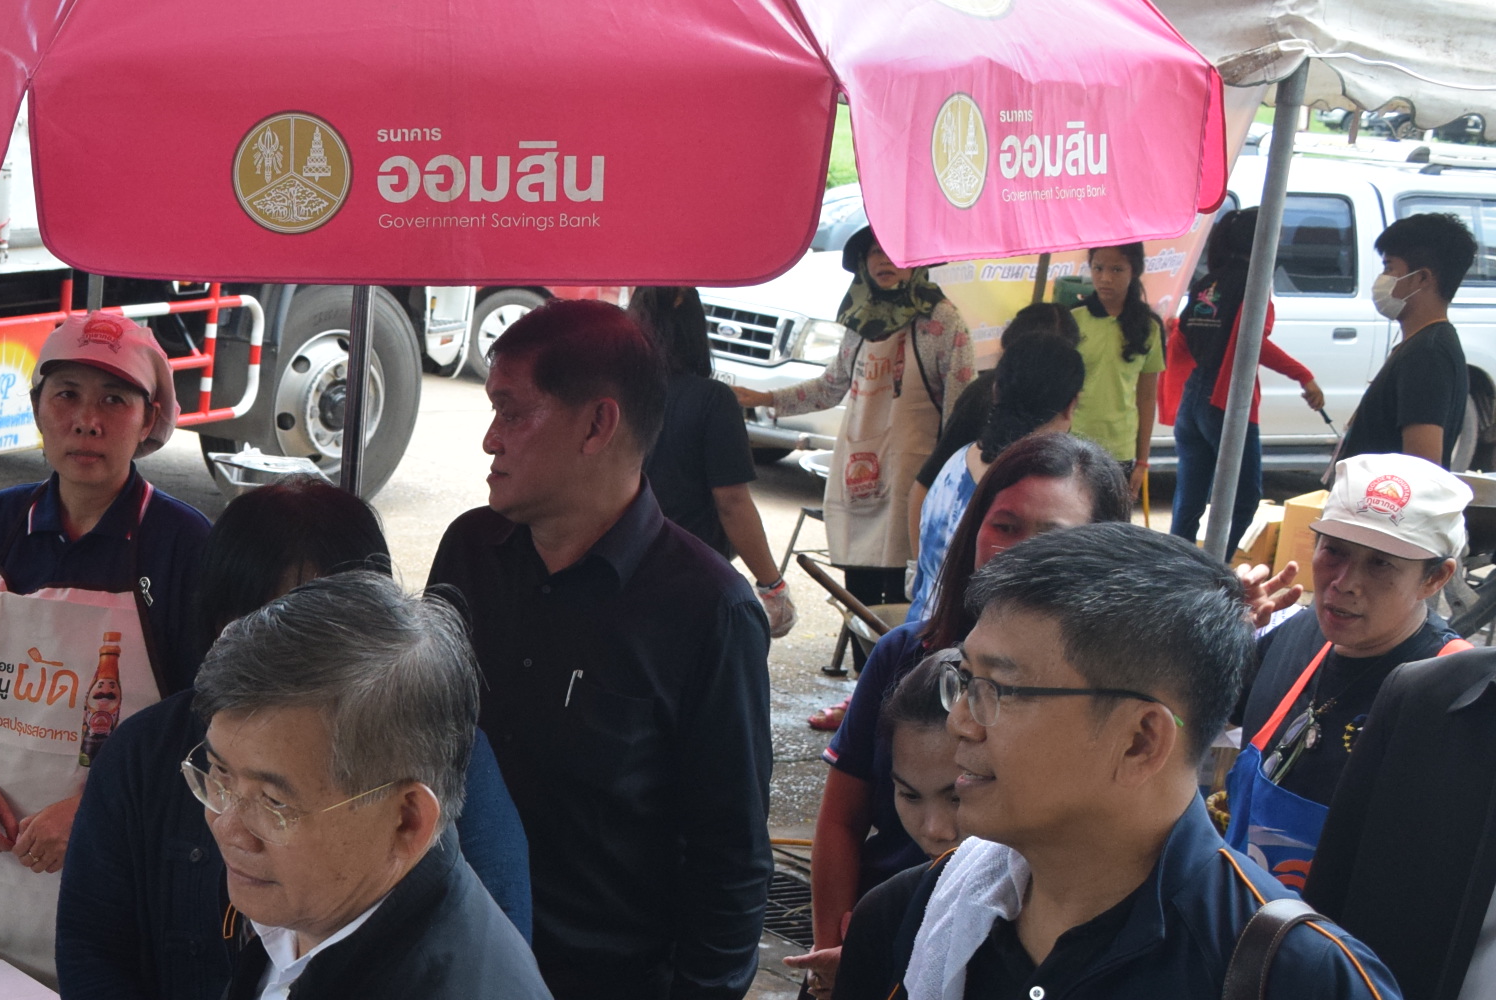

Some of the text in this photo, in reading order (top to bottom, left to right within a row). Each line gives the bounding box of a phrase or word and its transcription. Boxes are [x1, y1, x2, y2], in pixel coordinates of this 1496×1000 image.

[999, 109, 1033, 122] ธนาคาร
[377, 127, 442, 143] ธนาคาร
[999, 121, 1107, 179] ออมสิน
[376, 140, 605, 203] ออมสิน
[1001, 184, 1106, 202] Government Savings Bank
[378, 213, 601, 231] Government Savings Bank
[13, 646, 79, 709] ผัด
